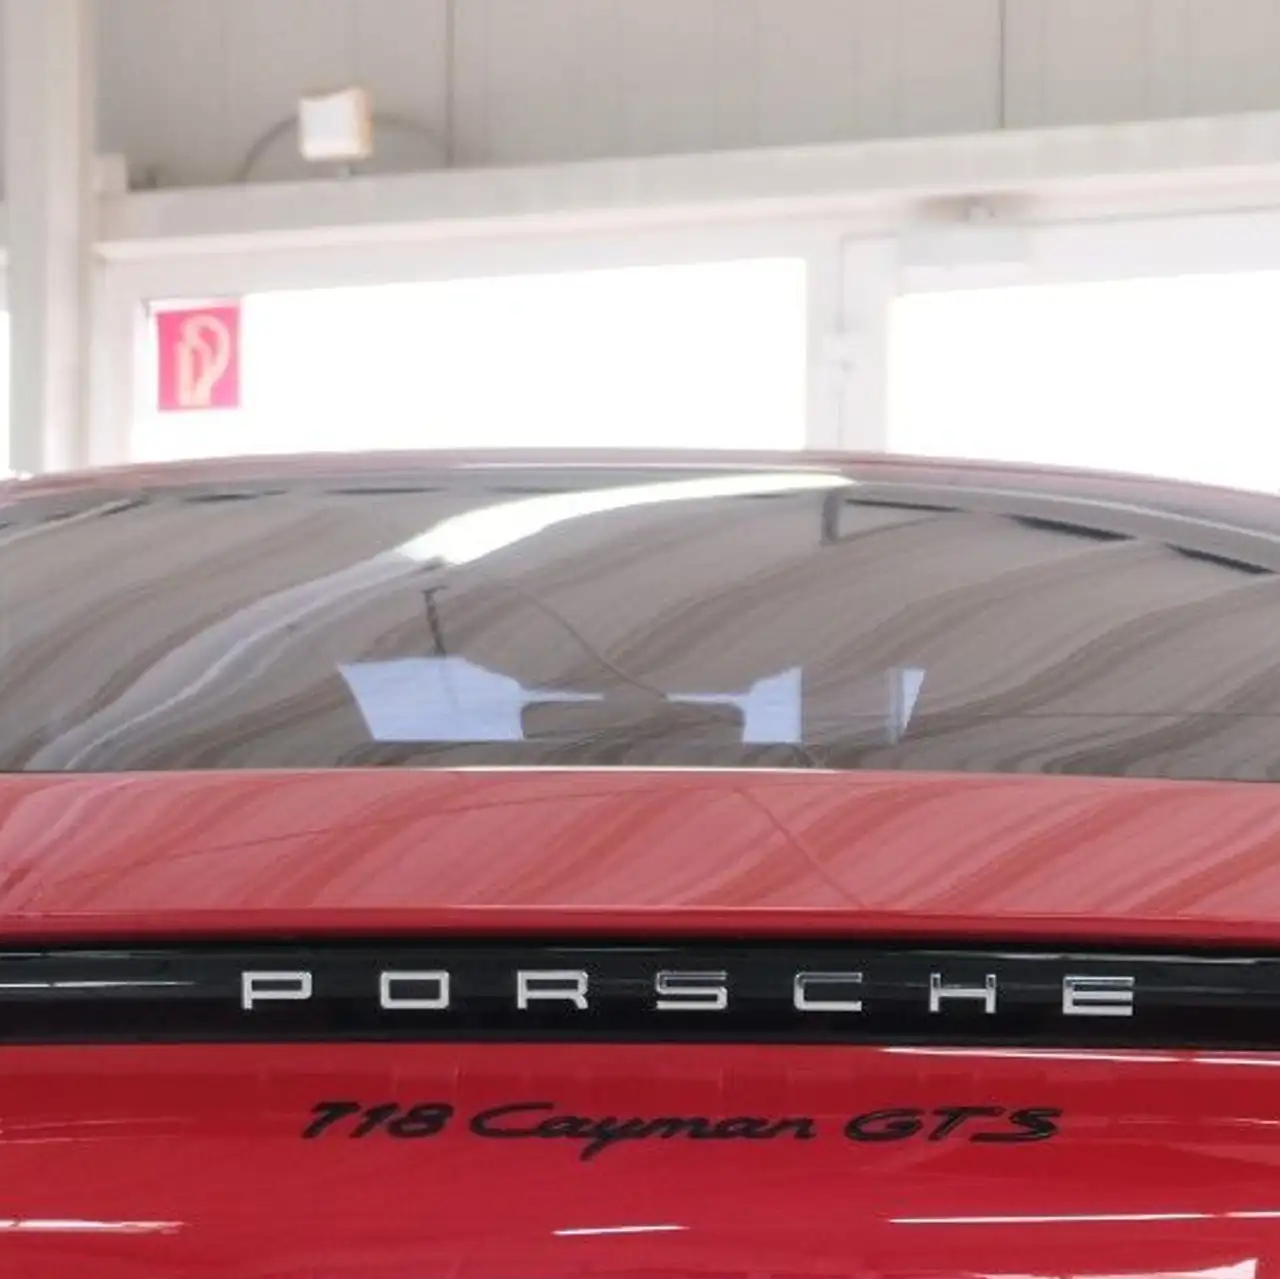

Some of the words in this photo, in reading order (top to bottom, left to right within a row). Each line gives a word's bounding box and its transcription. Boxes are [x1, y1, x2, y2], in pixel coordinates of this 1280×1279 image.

[240, 970, 1134, 1016] PORSCHE
[300, 1100, 455, 1139] 718
[468, 1101, 817, 1162] Cayman
[843, 1105, 1064, 1143] GTS
